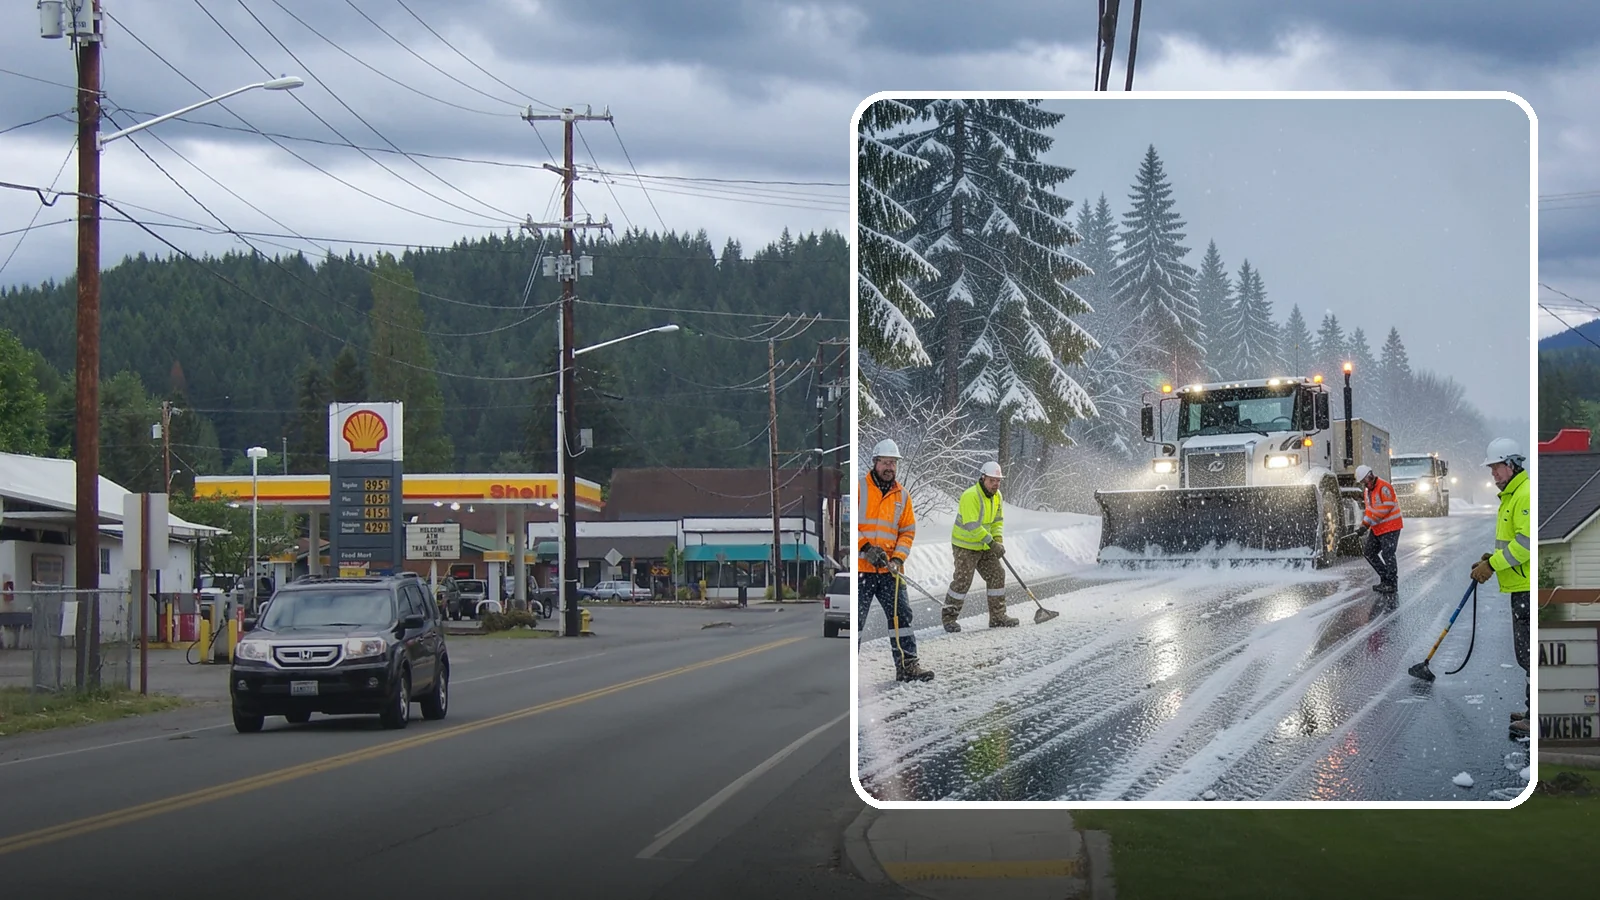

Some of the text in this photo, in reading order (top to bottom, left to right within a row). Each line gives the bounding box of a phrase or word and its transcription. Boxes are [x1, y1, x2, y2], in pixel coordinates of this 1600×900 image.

[366, 480, 383, 490] 395
[490, 484, 547, 499] Shell
[366, 494, 383, 504] 405
[366, 508, 383, 518] 415
[366, 522, 383, 532] 429
